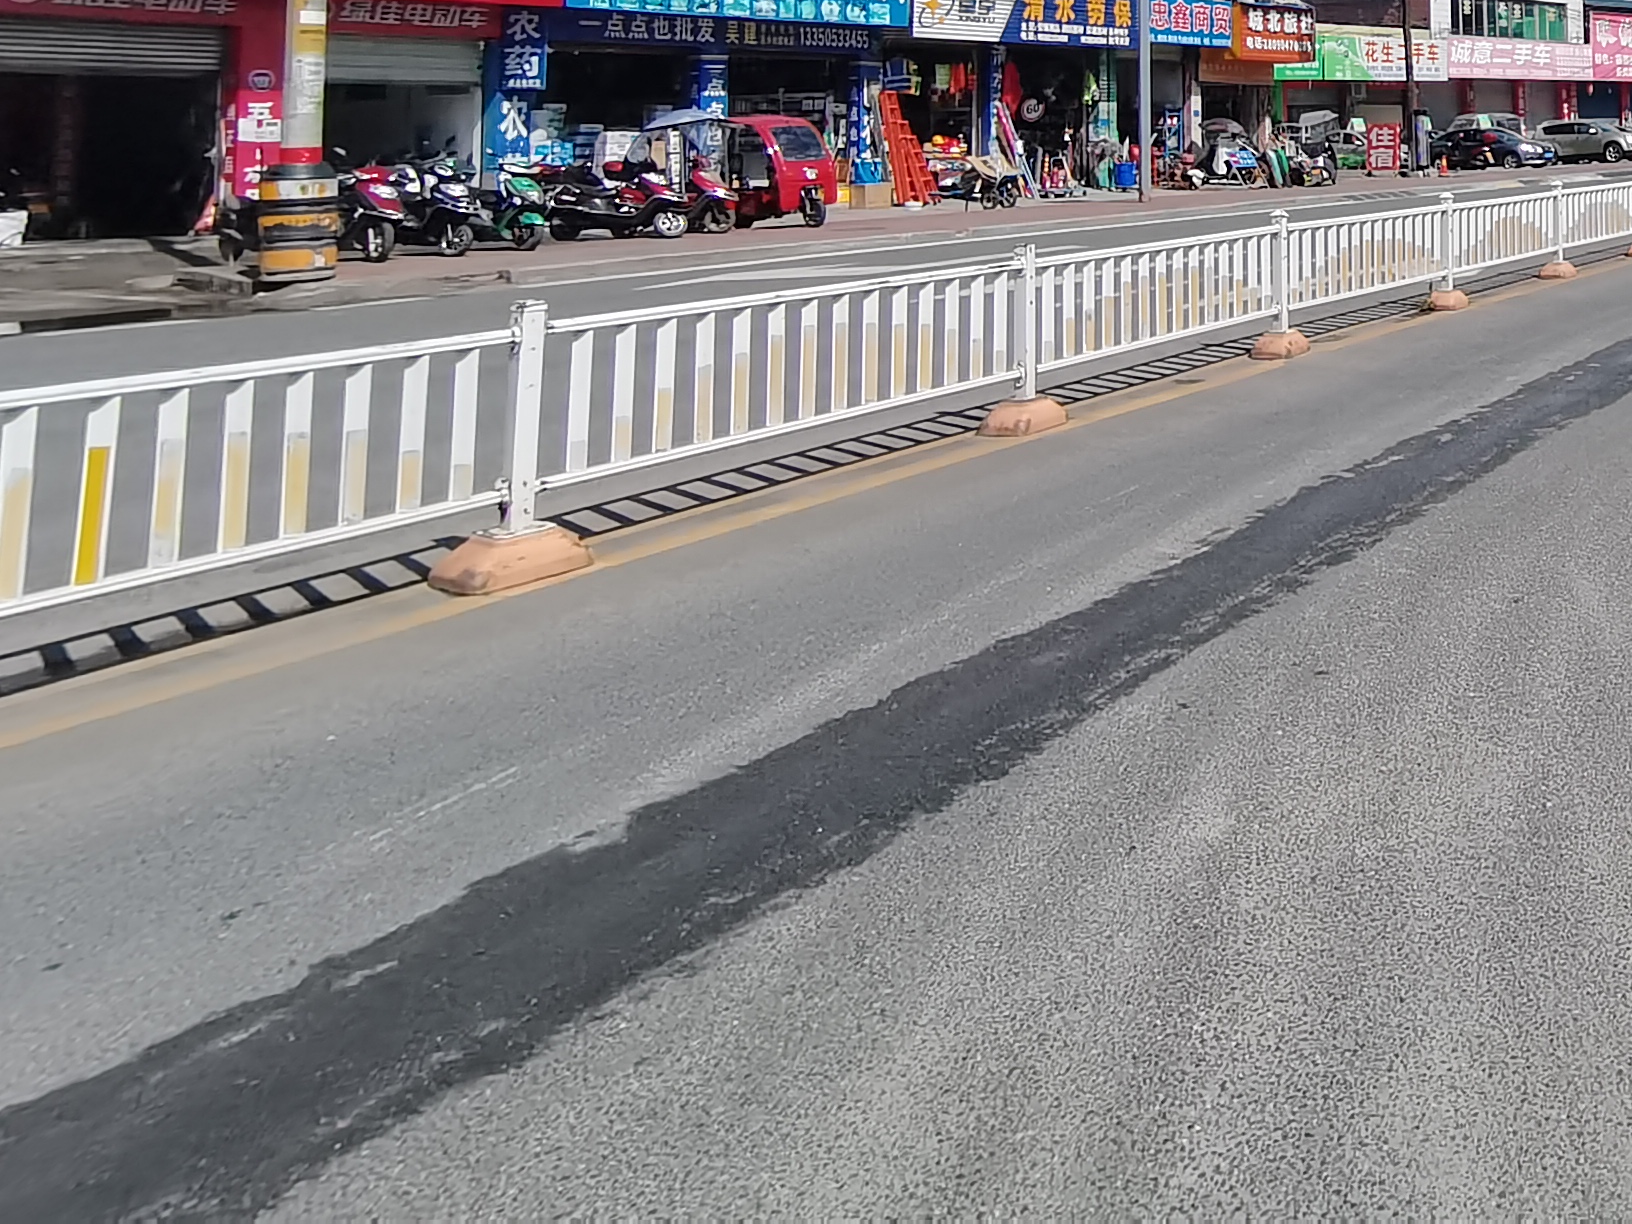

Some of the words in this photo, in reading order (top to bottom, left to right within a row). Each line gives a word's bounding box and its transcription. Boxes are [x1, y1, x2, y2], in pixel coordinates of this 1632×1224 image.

[338, 0, 490, 28] 绿佳电动车
[578, 11, 715, 43] 一点点也批发
[1248, 7, 1314, 34] 城北旅社
[502, 10, 542, 77] 农药
[1364, 40, 1440, 65] 花生二手车
[1450, 39, 1552, 66] 诚意二手车
[1368, 126, 1396, 169] 住宿
